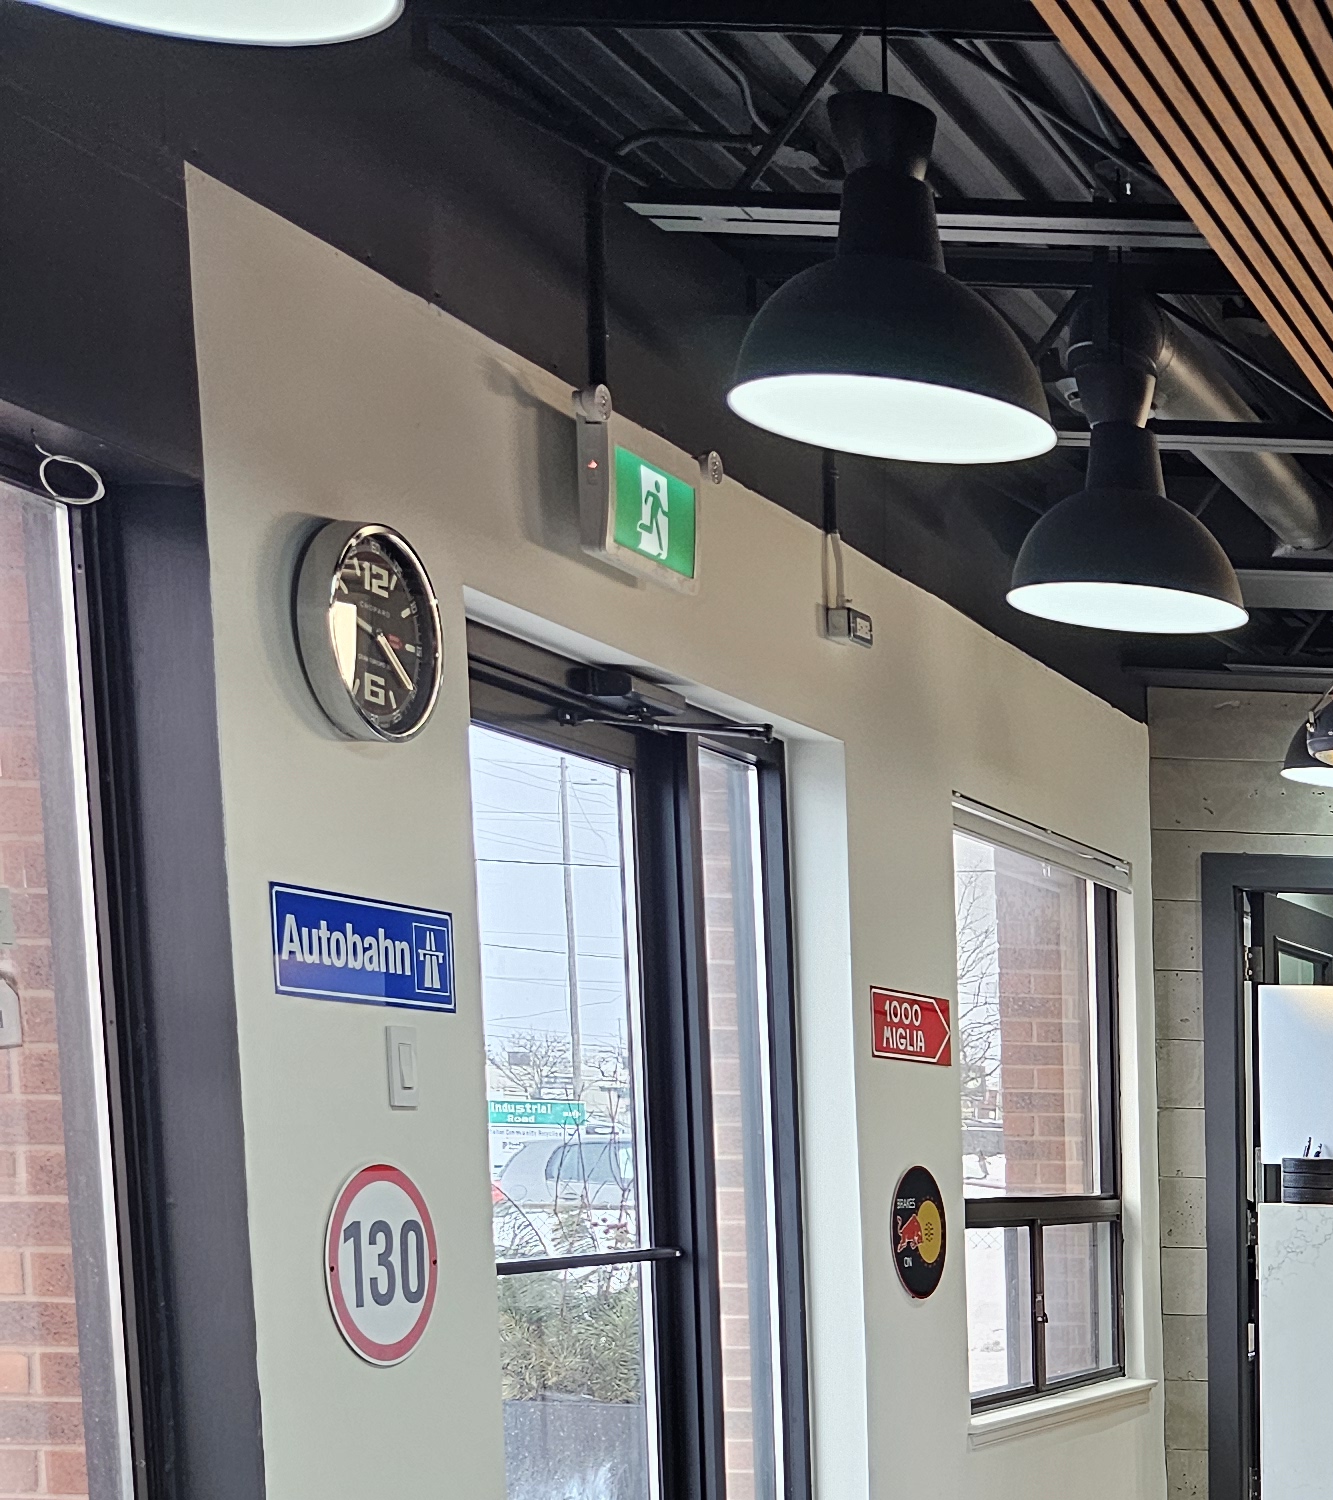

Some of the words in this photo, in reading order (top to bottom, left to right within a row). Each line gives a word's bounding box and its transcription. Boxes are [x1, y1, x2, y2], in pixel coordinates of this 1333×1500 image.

[362, 561, 389, 598] 12
[364, 672, 386, 706] 6
[281, 913, 412, 976] Autobahn
[884, 999, 922, 1027] 1000
[882, 1025, 925, 1053] MIGLIA
[490, 1102, 553, 1114] Industrial
[507, 1114, 536, 1123] Road
[343, 1219, 426, 1309] 130
